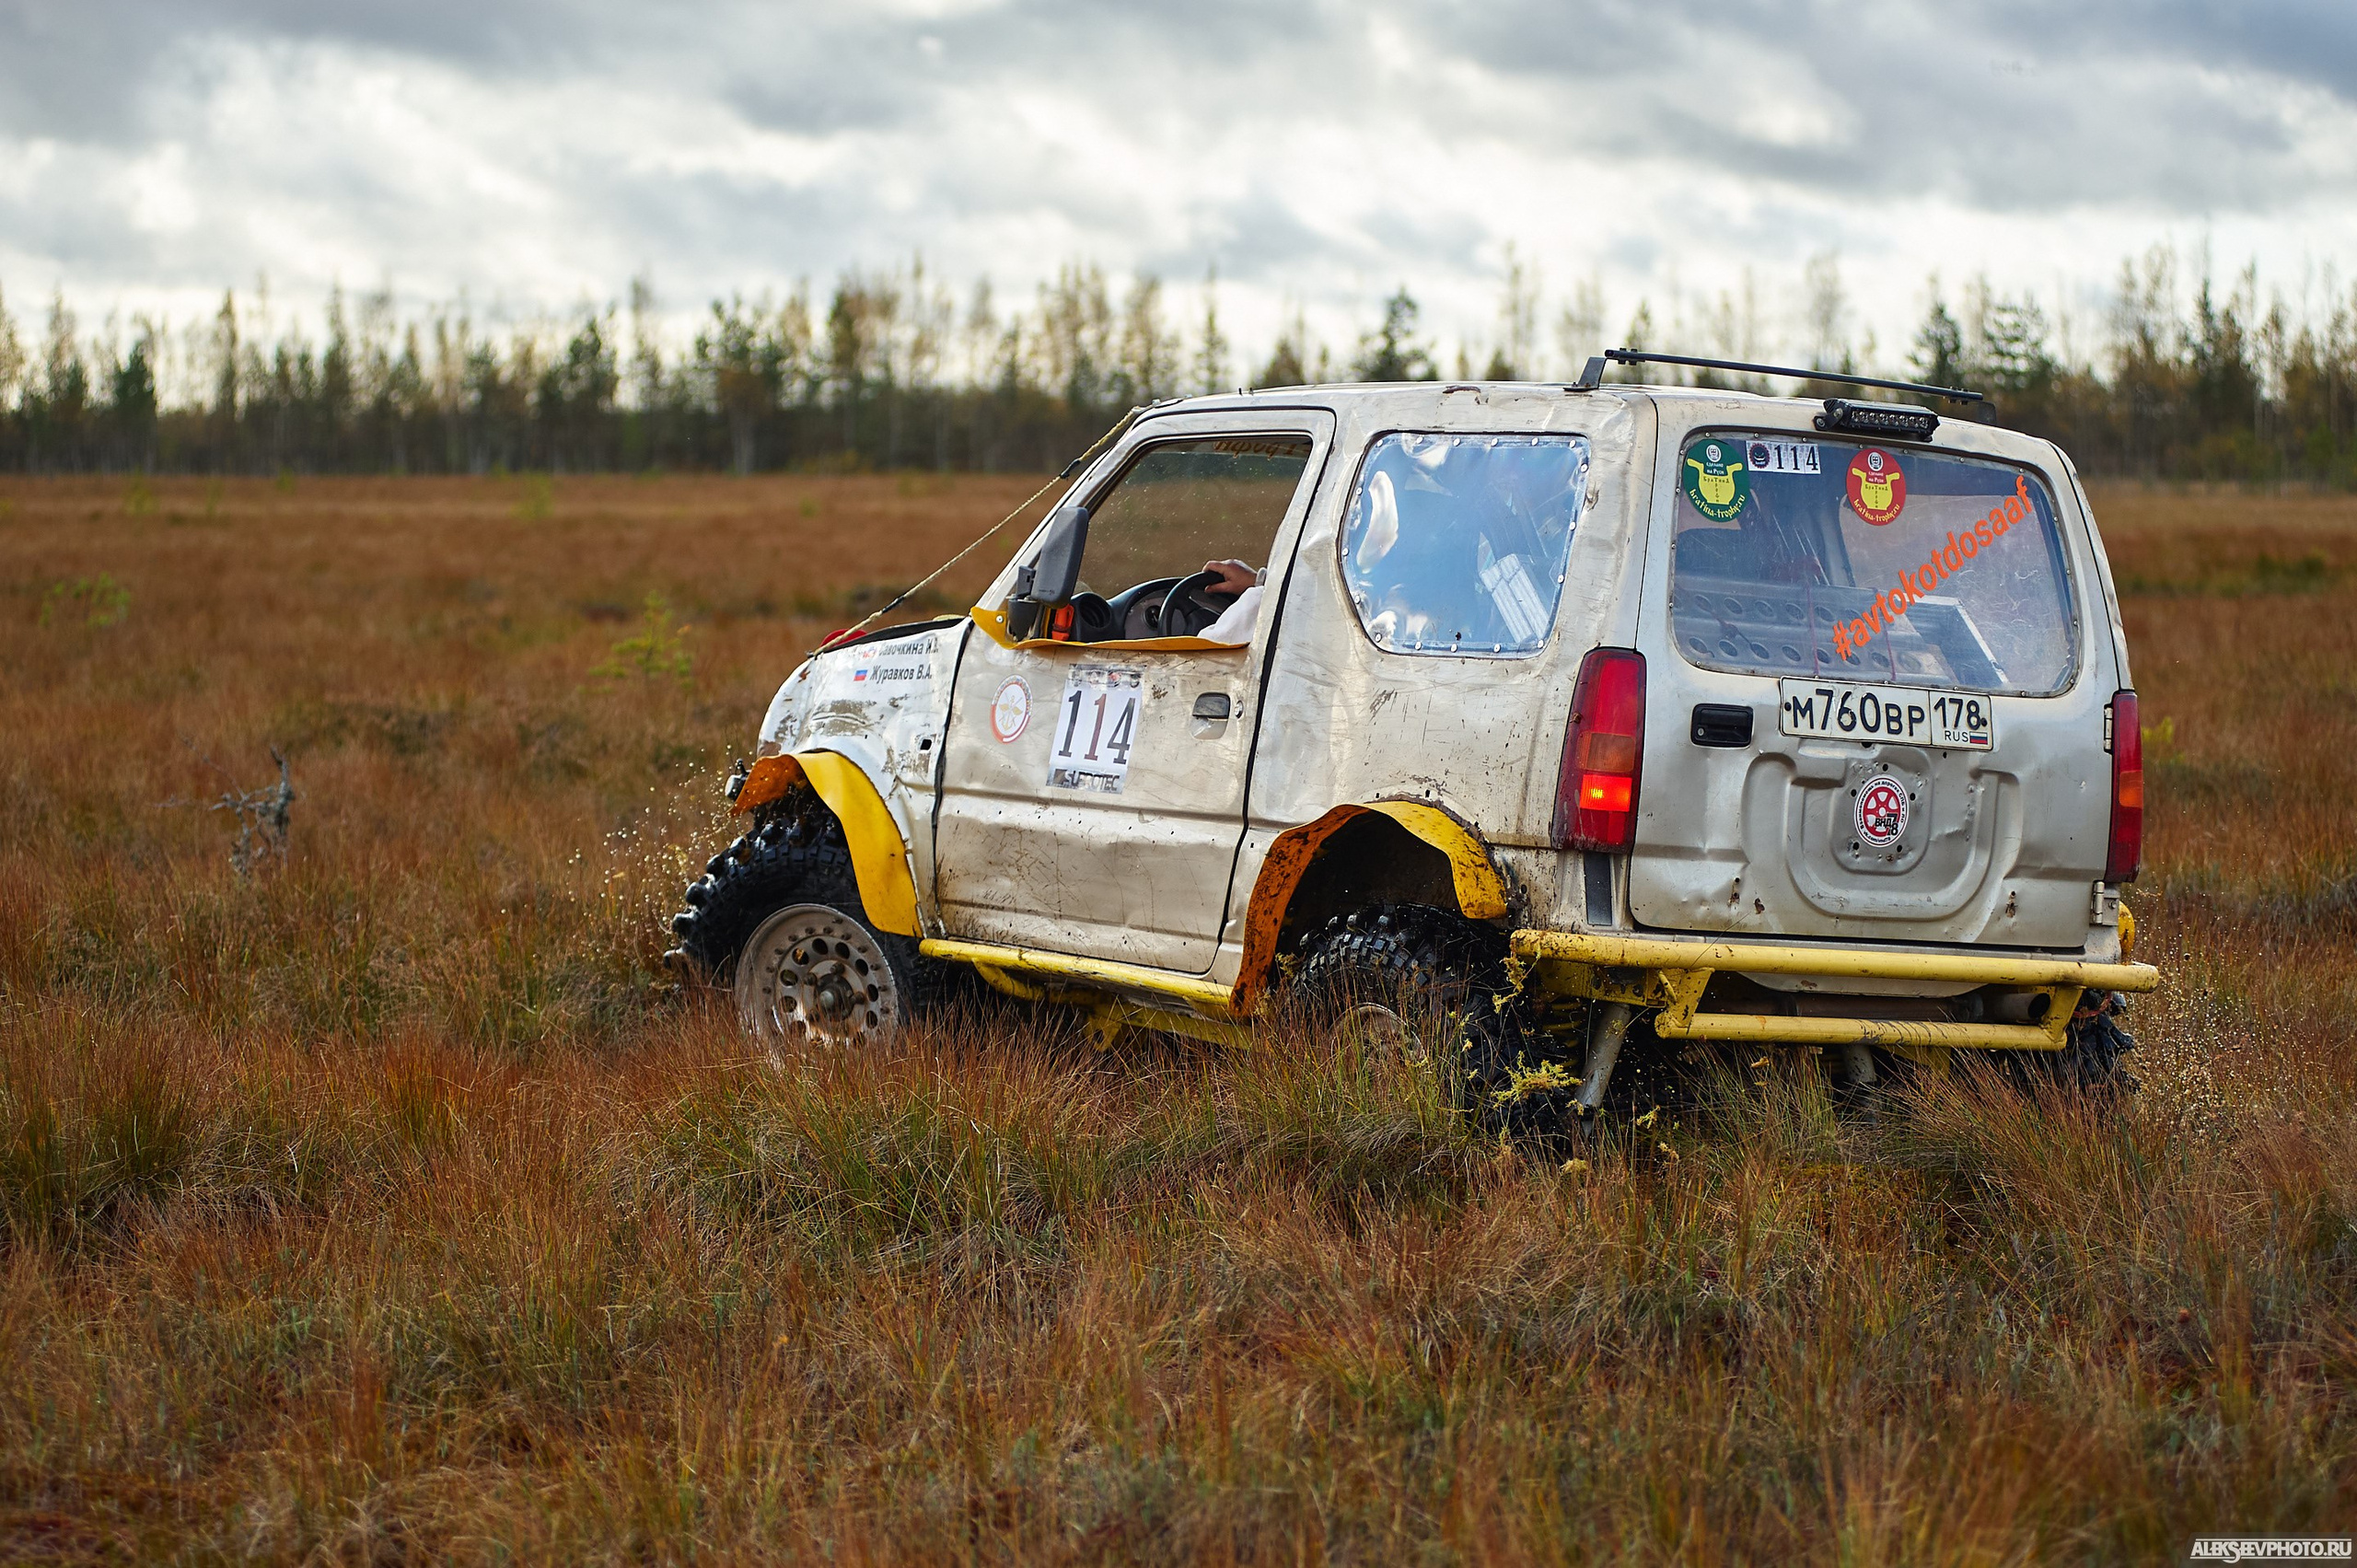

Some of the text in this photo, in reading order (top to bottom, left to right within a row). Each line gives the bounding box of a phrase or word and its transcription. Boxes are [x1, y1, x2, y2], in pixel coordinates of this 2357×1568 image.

[1774, 445, 1818, 470] 114
[1832, 475, 2032, 660] #avtokotdosaaf
[869, 664, 933, 684] Журавков В.А.
[1933, 697, 1981, 731] 178
[1058, 691, 1136, 764] 114
[1945, 730, 1969, 743] RUS
[1875, 818, 1892, 829] ВНД
